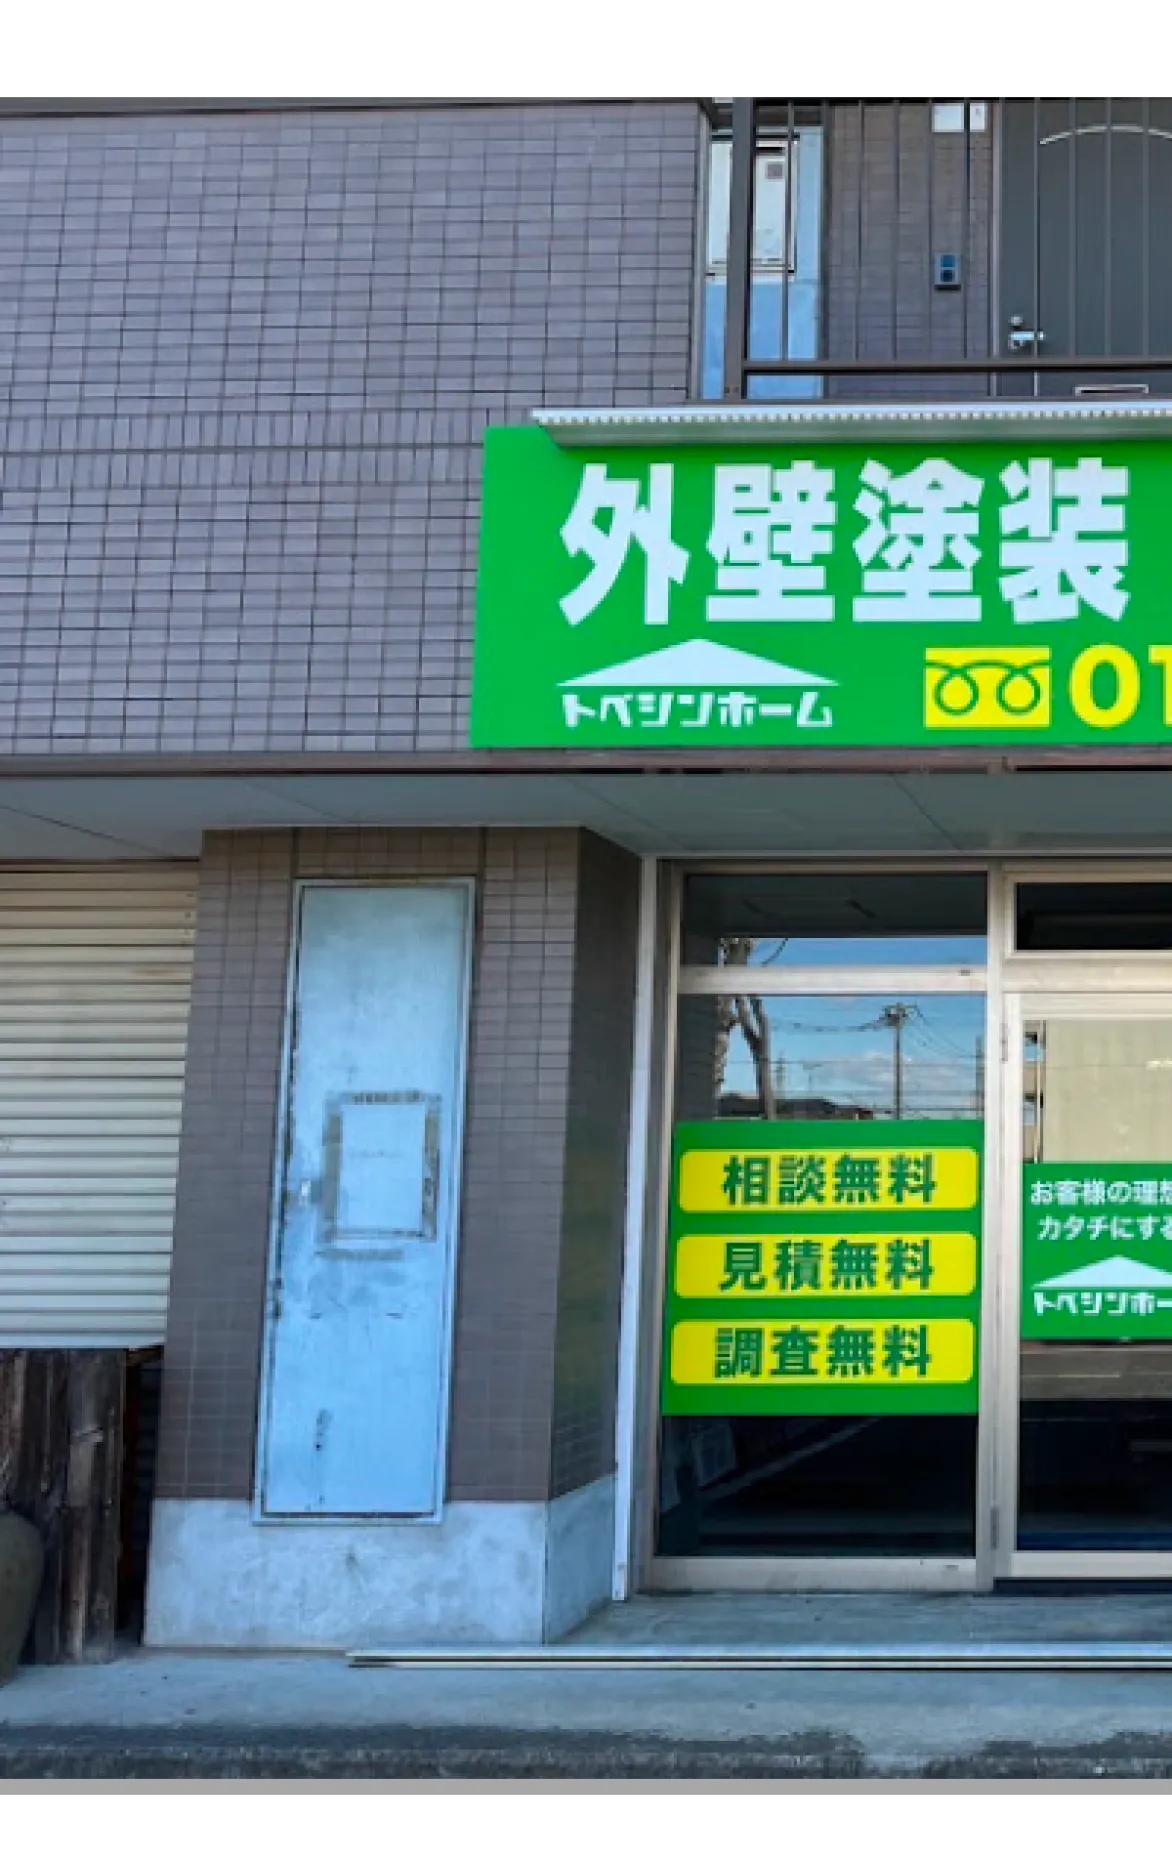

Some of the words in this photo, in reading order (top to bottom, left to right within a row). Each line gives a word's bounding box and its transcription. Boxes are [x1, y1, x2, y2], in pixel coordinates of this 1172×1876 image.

[560, 458, 1129, 625] 外壁塗装
[722, 1154, 936, 1206] 相談無料
[718, 1238, 935, 1291] 見積無料
[714, 1324, 932, 1379] 調査無料
